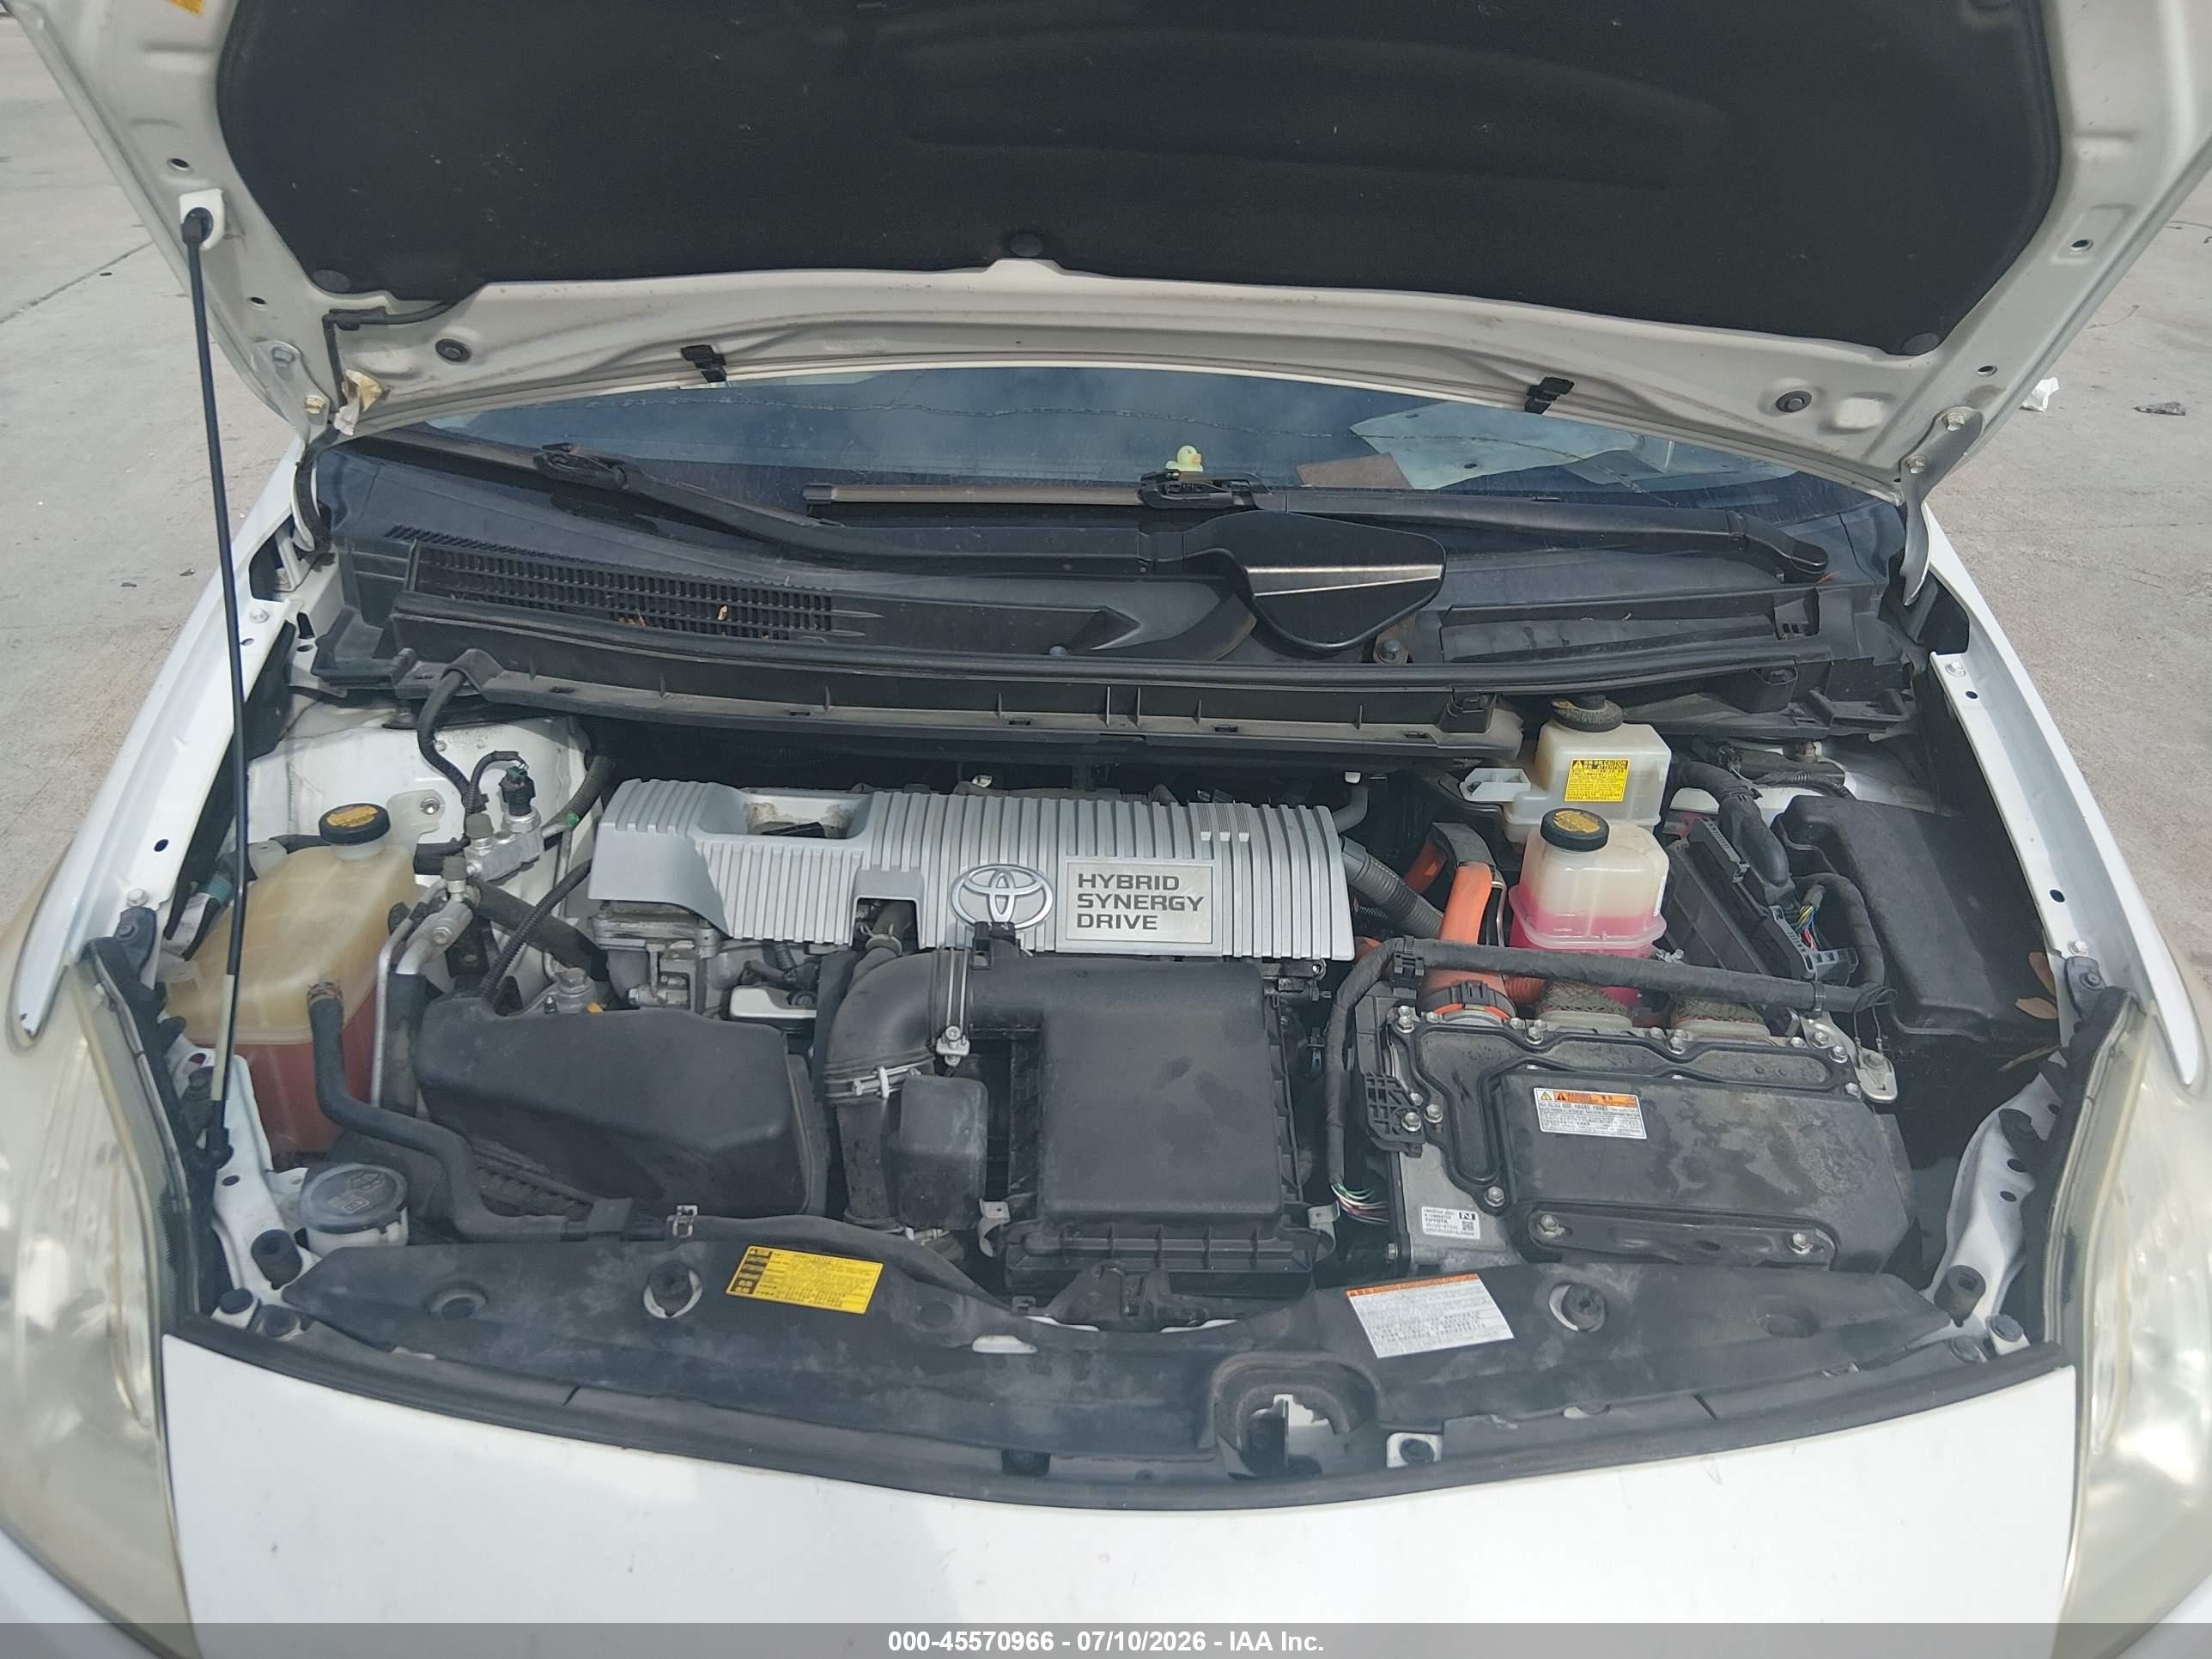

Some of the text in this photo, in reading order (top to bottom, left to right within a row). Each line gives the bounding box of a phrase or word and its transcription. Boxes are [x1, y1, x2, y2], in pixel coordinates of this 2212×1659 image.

[1078, 872, 1180, 890] HYBRID
[1077, 893, 1204, 911] SYNERGY
[1077, 913, 1158, 930] DRIVE
